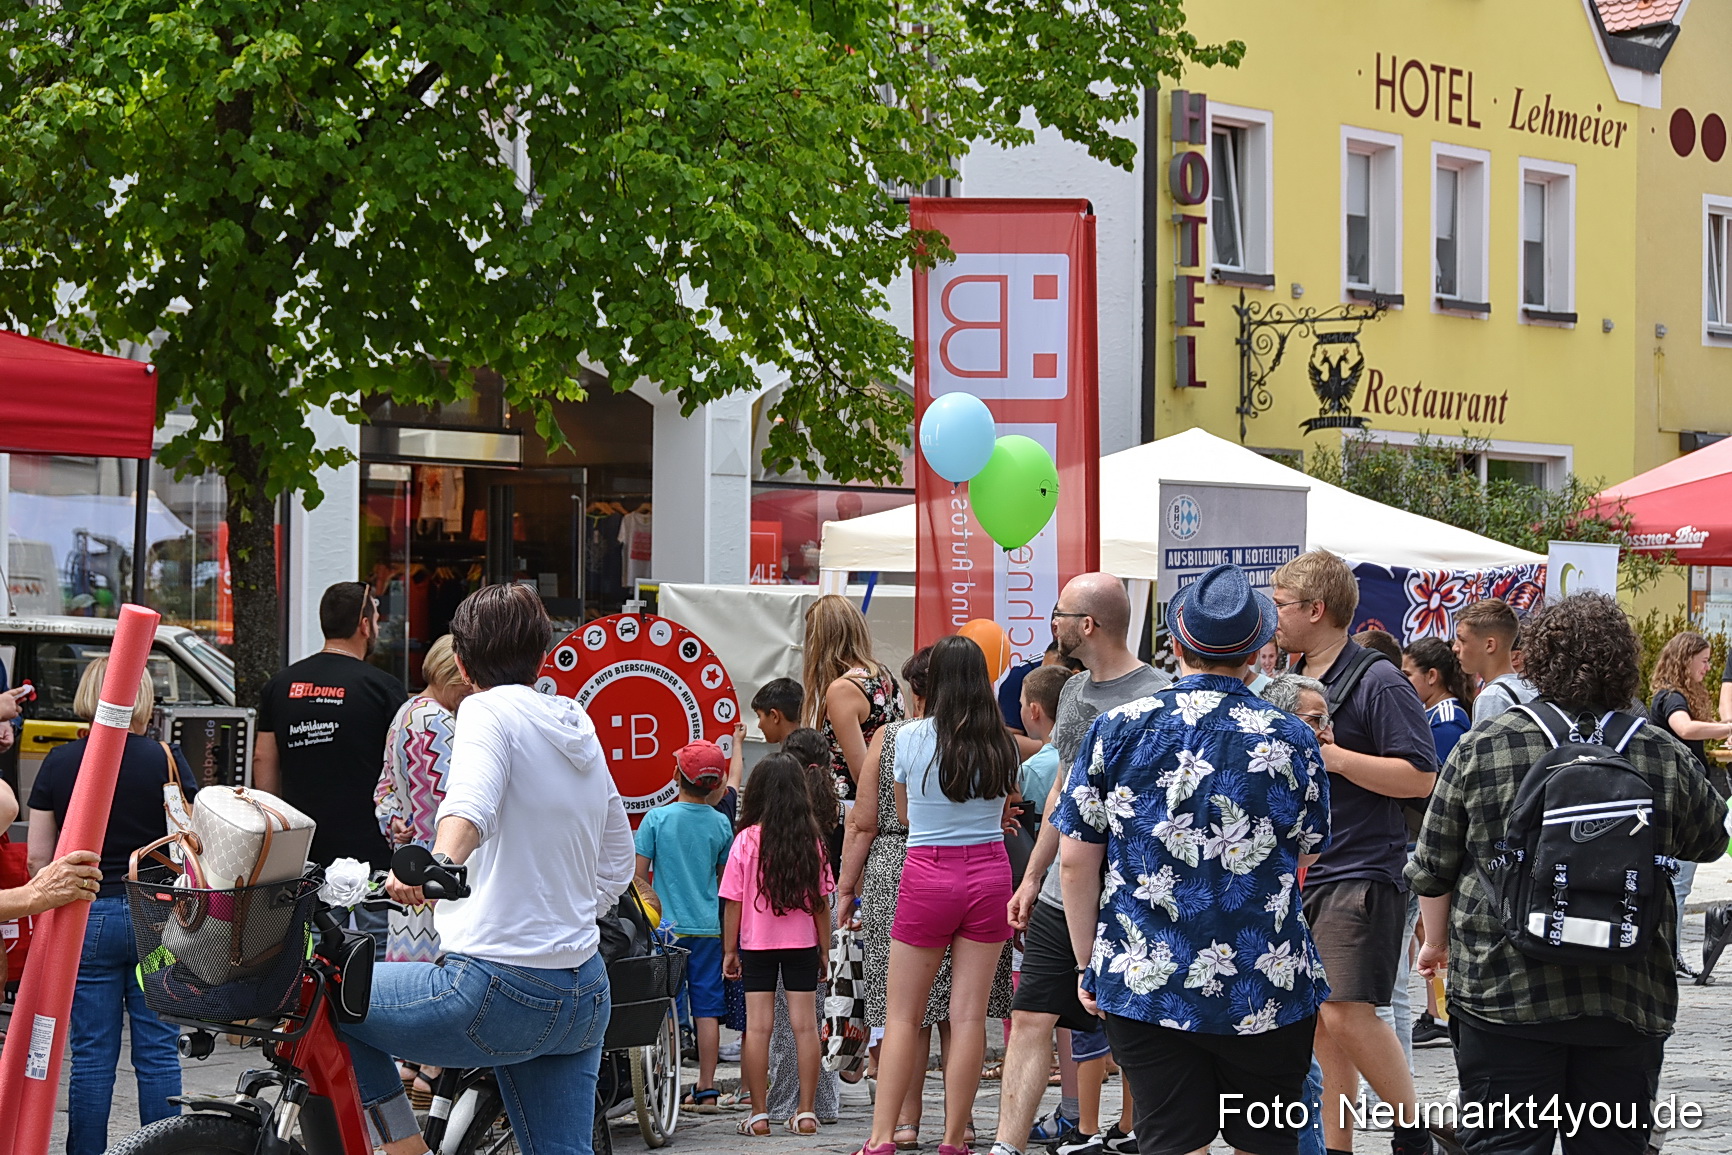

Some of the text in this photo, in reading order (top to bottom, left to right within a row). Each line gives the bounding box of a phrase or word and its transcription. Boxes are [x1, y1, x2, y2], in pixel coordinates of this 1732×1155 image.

[1375, 52, 1628, 149] HOTEL Lehmeier
[1170, 89, 1209, 388] HOTEL
[1361, 368, 1509, 425] Restaurant
[750, 563, 777, 584] ALE
[1167, 547, 1297, 567] AUSBILDUNG IN HOTELLERIE
[578, 663, 701, 740] DER AUTO BIERSCHNEIDER AUTO BIERS
[289, 719, 335, 736] Ausbildung
[657, 786, 676, 801] AUTO
